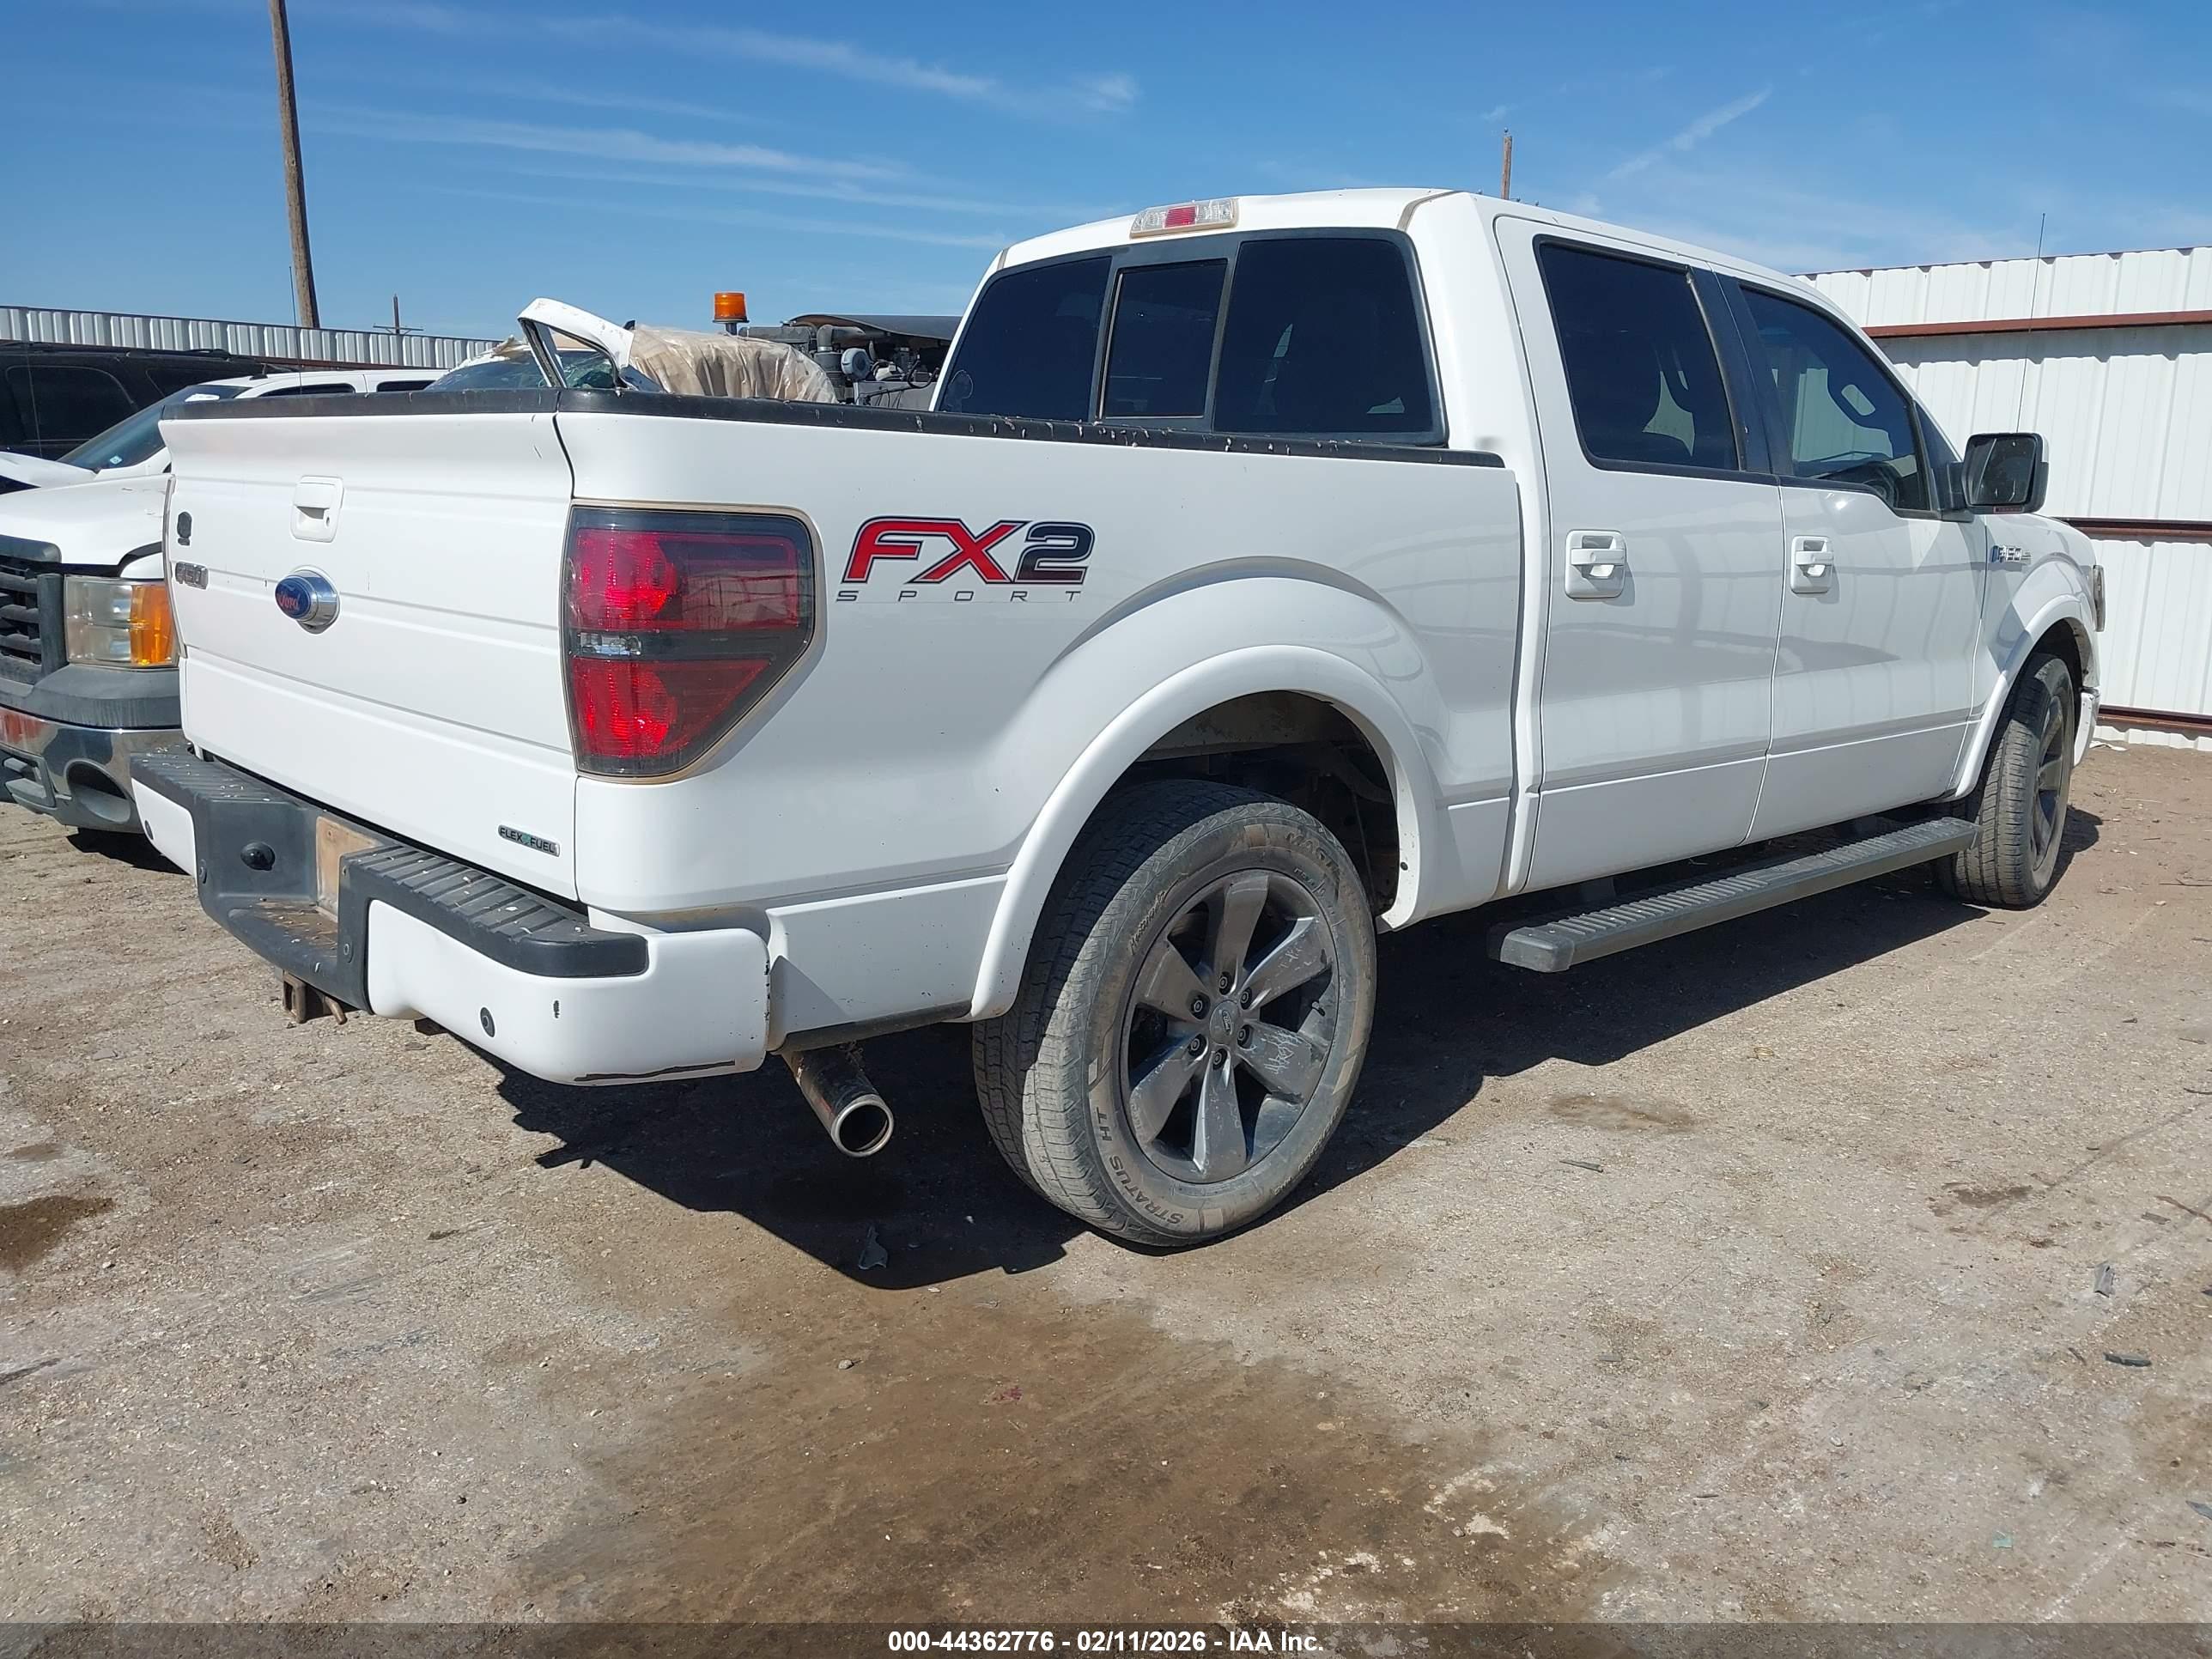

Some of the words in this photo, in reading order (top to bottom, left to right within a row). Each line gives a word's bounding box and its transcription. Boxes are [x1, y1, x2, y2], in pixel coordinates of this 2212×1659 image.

[841, 515, 1096, 585] FX2
[836, 590, 1081, 603] SPORT
[500, 827, 523, 843] FLEX
[530, 837, 555, 854] FUEL
[1096, 1107, 1113, 1142] HT
[1109, 1155, 1184, 1224] STRATUS
